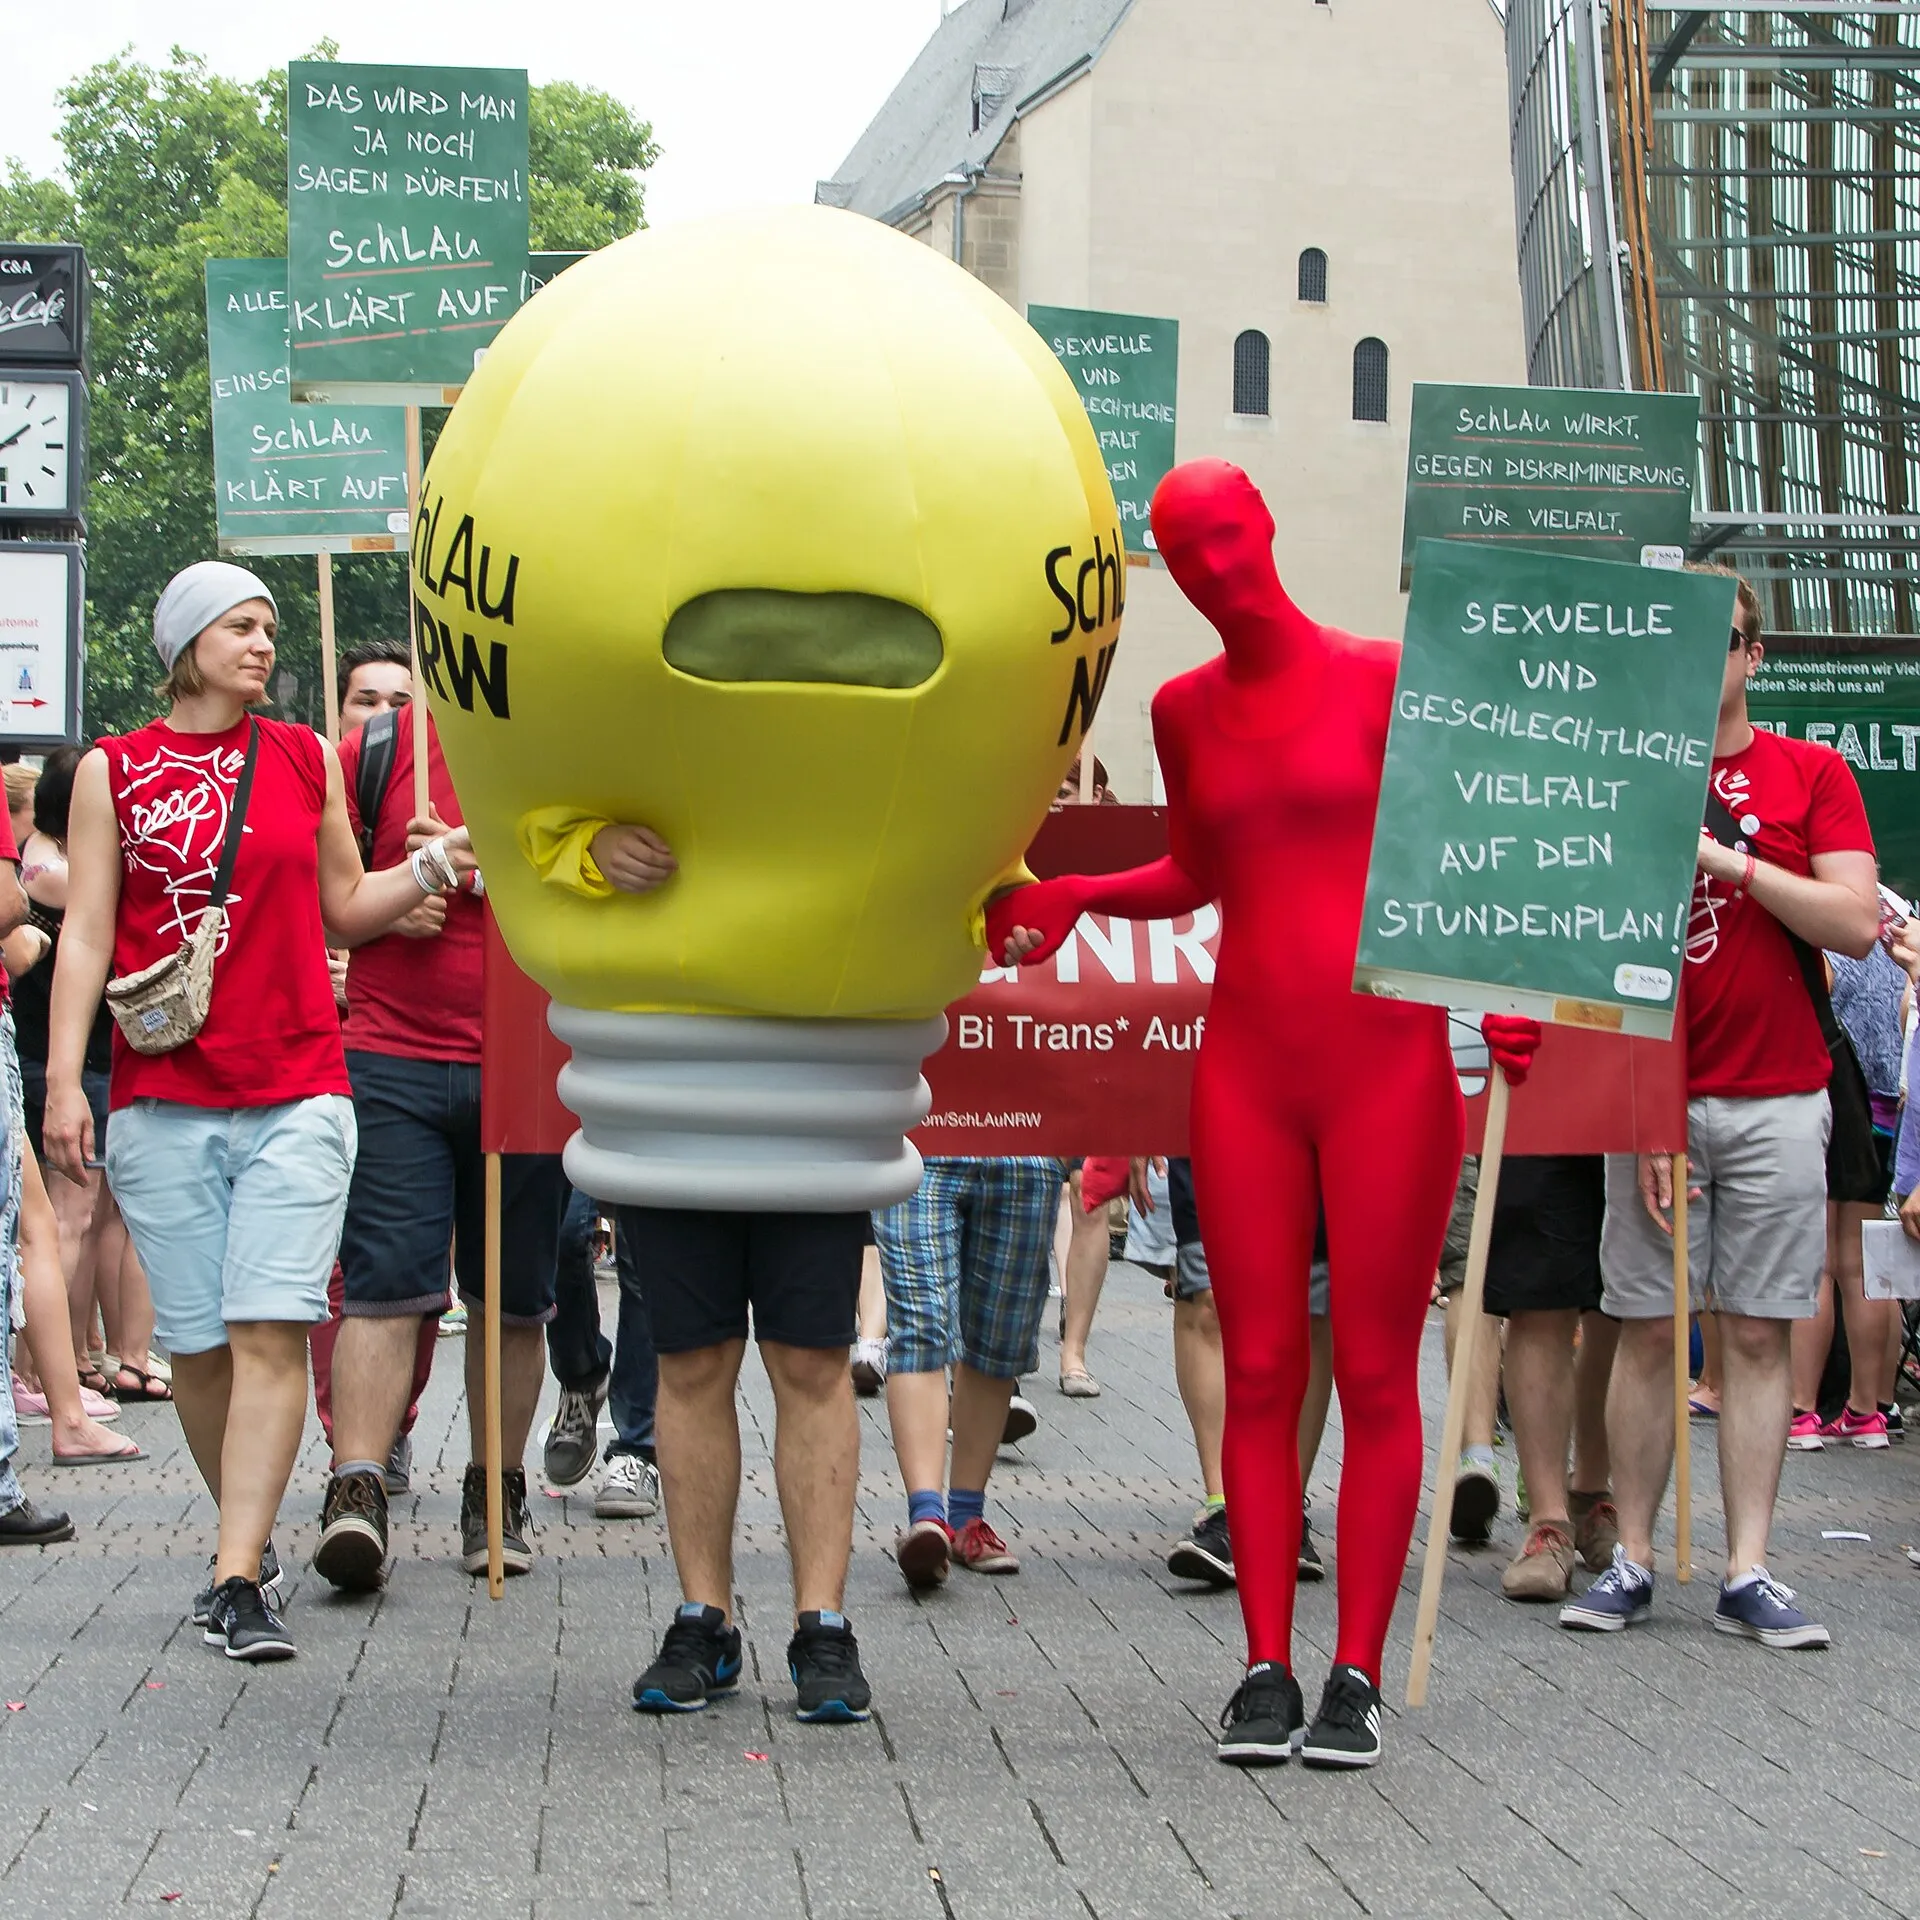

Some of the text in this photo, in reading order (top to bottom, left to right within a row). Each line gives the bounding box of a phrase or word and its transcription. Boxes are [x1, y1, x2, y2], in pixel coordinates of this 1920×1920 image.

[305, 83, 516, 123] DAS WIRD MAN
[353, 125, 475, 162] JA NOCH
[294, 164, 522, 202] SAGEN DÜRFEN!
[326, 222, 481, 268] SchLAu
[0, 259, 33, 274] C&A
[0, 288, 66, 328] cCafé
[226, 290, 290, 314] ALLE
[294, 287, 416, 332] KLÄRT
[1052, 334, 1153, 358] SEXUELLE
[1081, 367, 1121, 386] UND
[1080, 395, 1175, 423] LECHTLICHE
[1456, 404, 1640, 440] SchLAu WIRKT.
[251, 417, 373, 454] SchLAu
[1097, 429, 1141, 450] FALT
[226, 469, 327, 503] KLÄRT
[1414, 454, 1691, 489] GEGEN DISKRIMINIERUNG.
[1462, 502, 1625, 536] FÜR VIELFALT.
[412, 480, 520, 627] hLAu
[1044, 528, 1125, 645] SchL
[0, 618, 39, 628] utomat
[1460, 601, 1674, 638] SEXUELLE
[413, 588, 512, 721] RW
[1772, 659, 1870, 676] demonstrieren
[1871, 661, 1894, 676] wir
[1894, 661, 1920, 676] Viel
[1519, 659, 1598, 694] UND
[1745, 677, 1885, 694] ließen Sie sich uns an!
[1398, 690, 1709, 768] GESCHLECHTLICHE
[1454, 770, 1631, 812] VIELFALT
[1439, 832, 1613, 876] AUF DEN
[1377, 899, 1685, 955] STUNDENPLAN!
[958, 1015, 994, 1050] Bi
[921, 1111, 1042, 1129] om/SchLAuNRW
